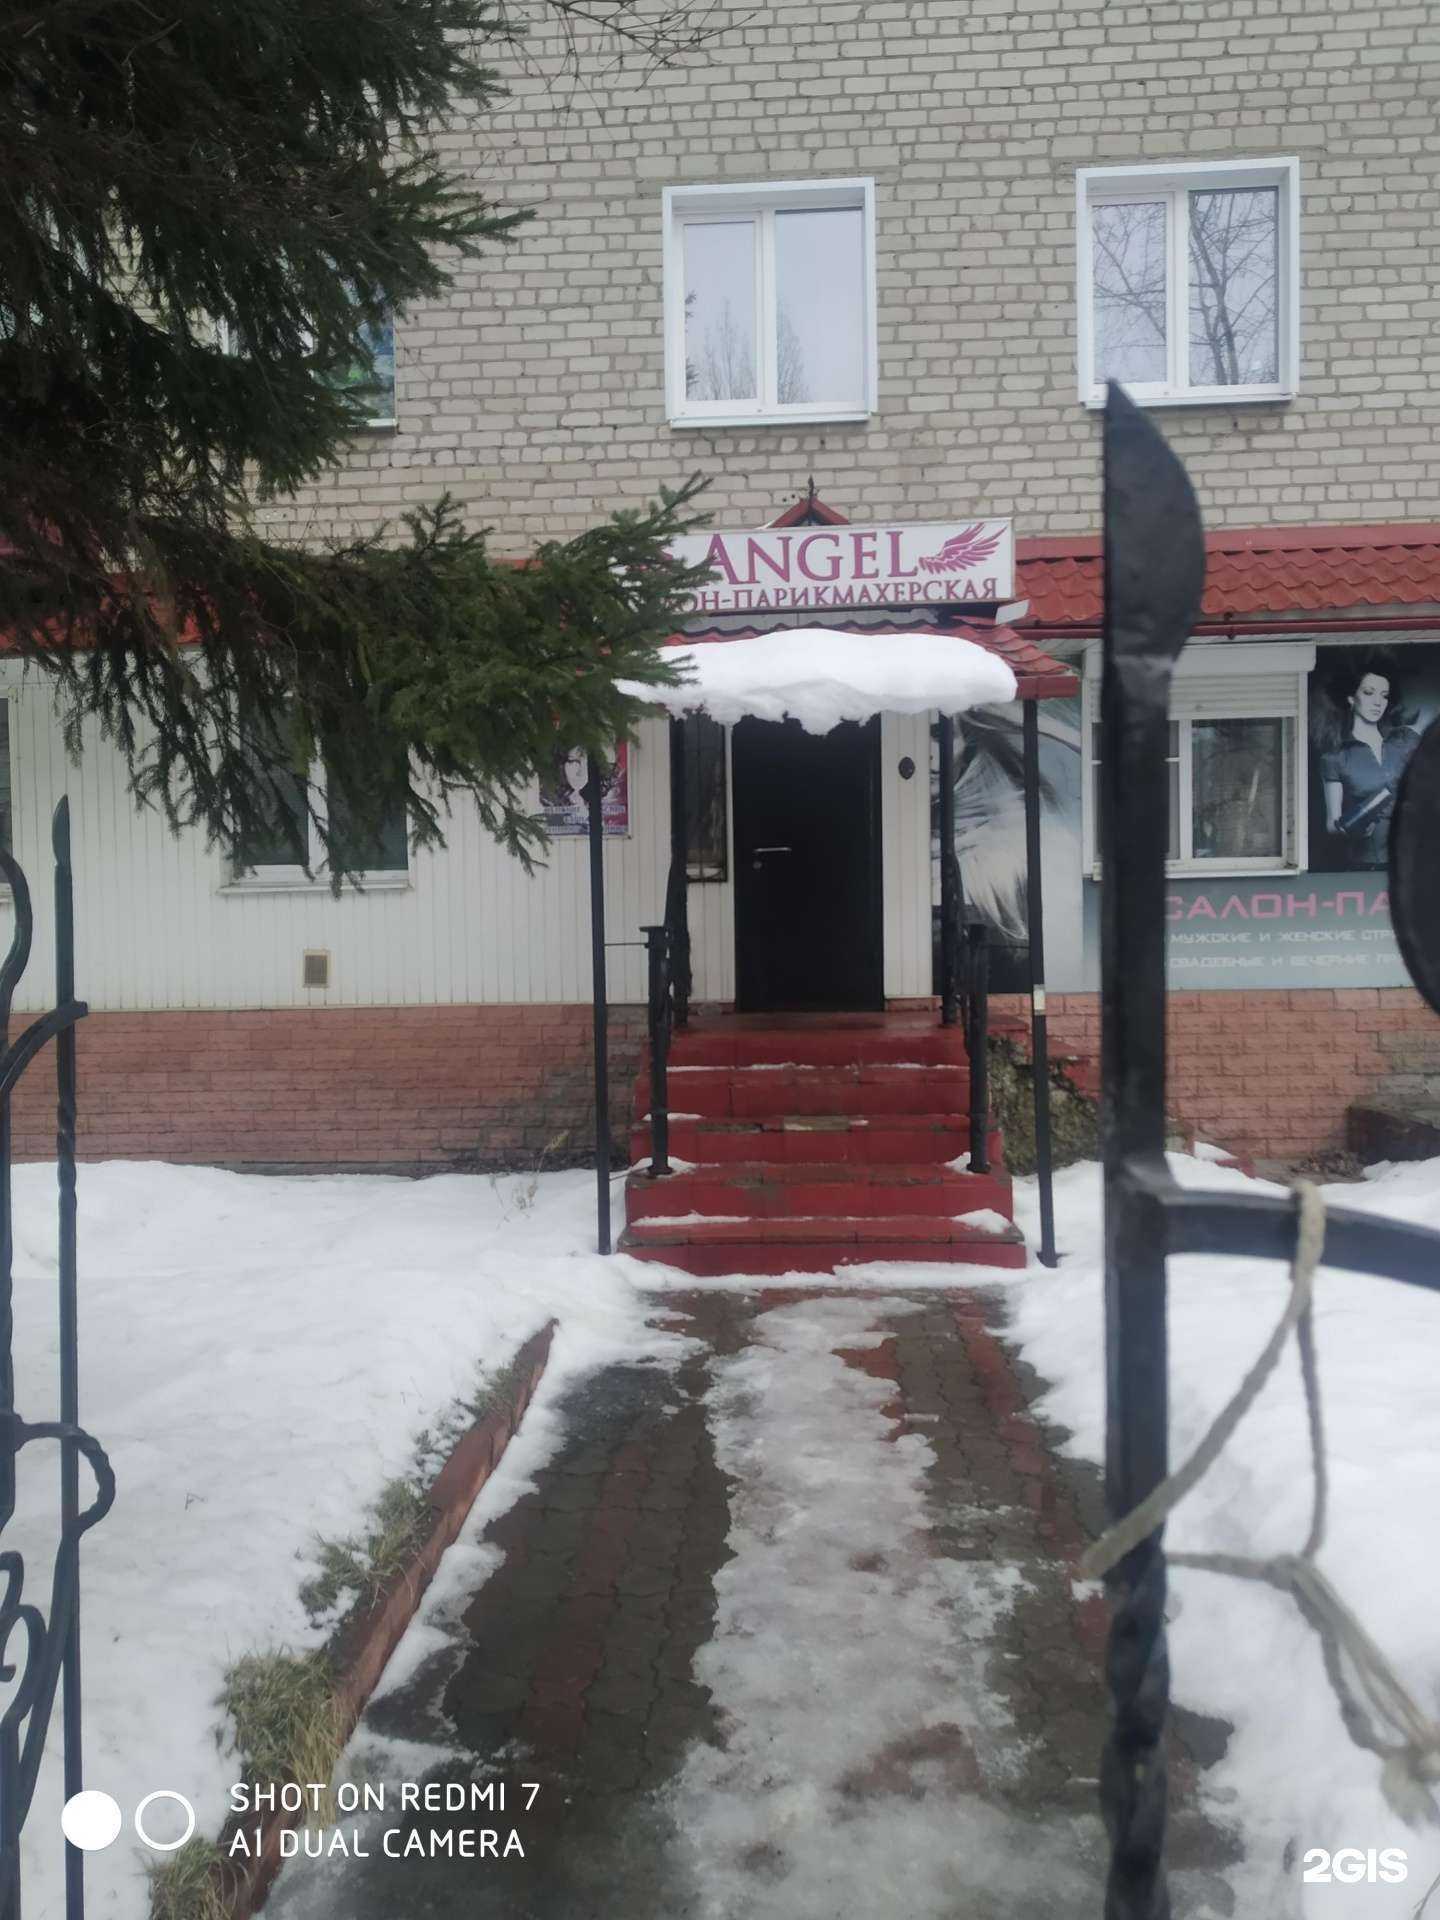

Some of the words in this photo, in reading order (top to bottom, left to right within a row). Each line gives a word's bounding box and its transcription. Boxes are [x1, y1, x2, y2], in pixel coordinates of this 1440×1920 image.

[704, 530, 918, 585] ANGEL
[681, 577, 998, 612] ОН-ПАРИКМАХЕРСКАЯ
[1166, 890, 1389, 920] САЛОН-ПА
[1259, 932, 1272, 943] И
[1361, 929, 1396, 941] СТР
